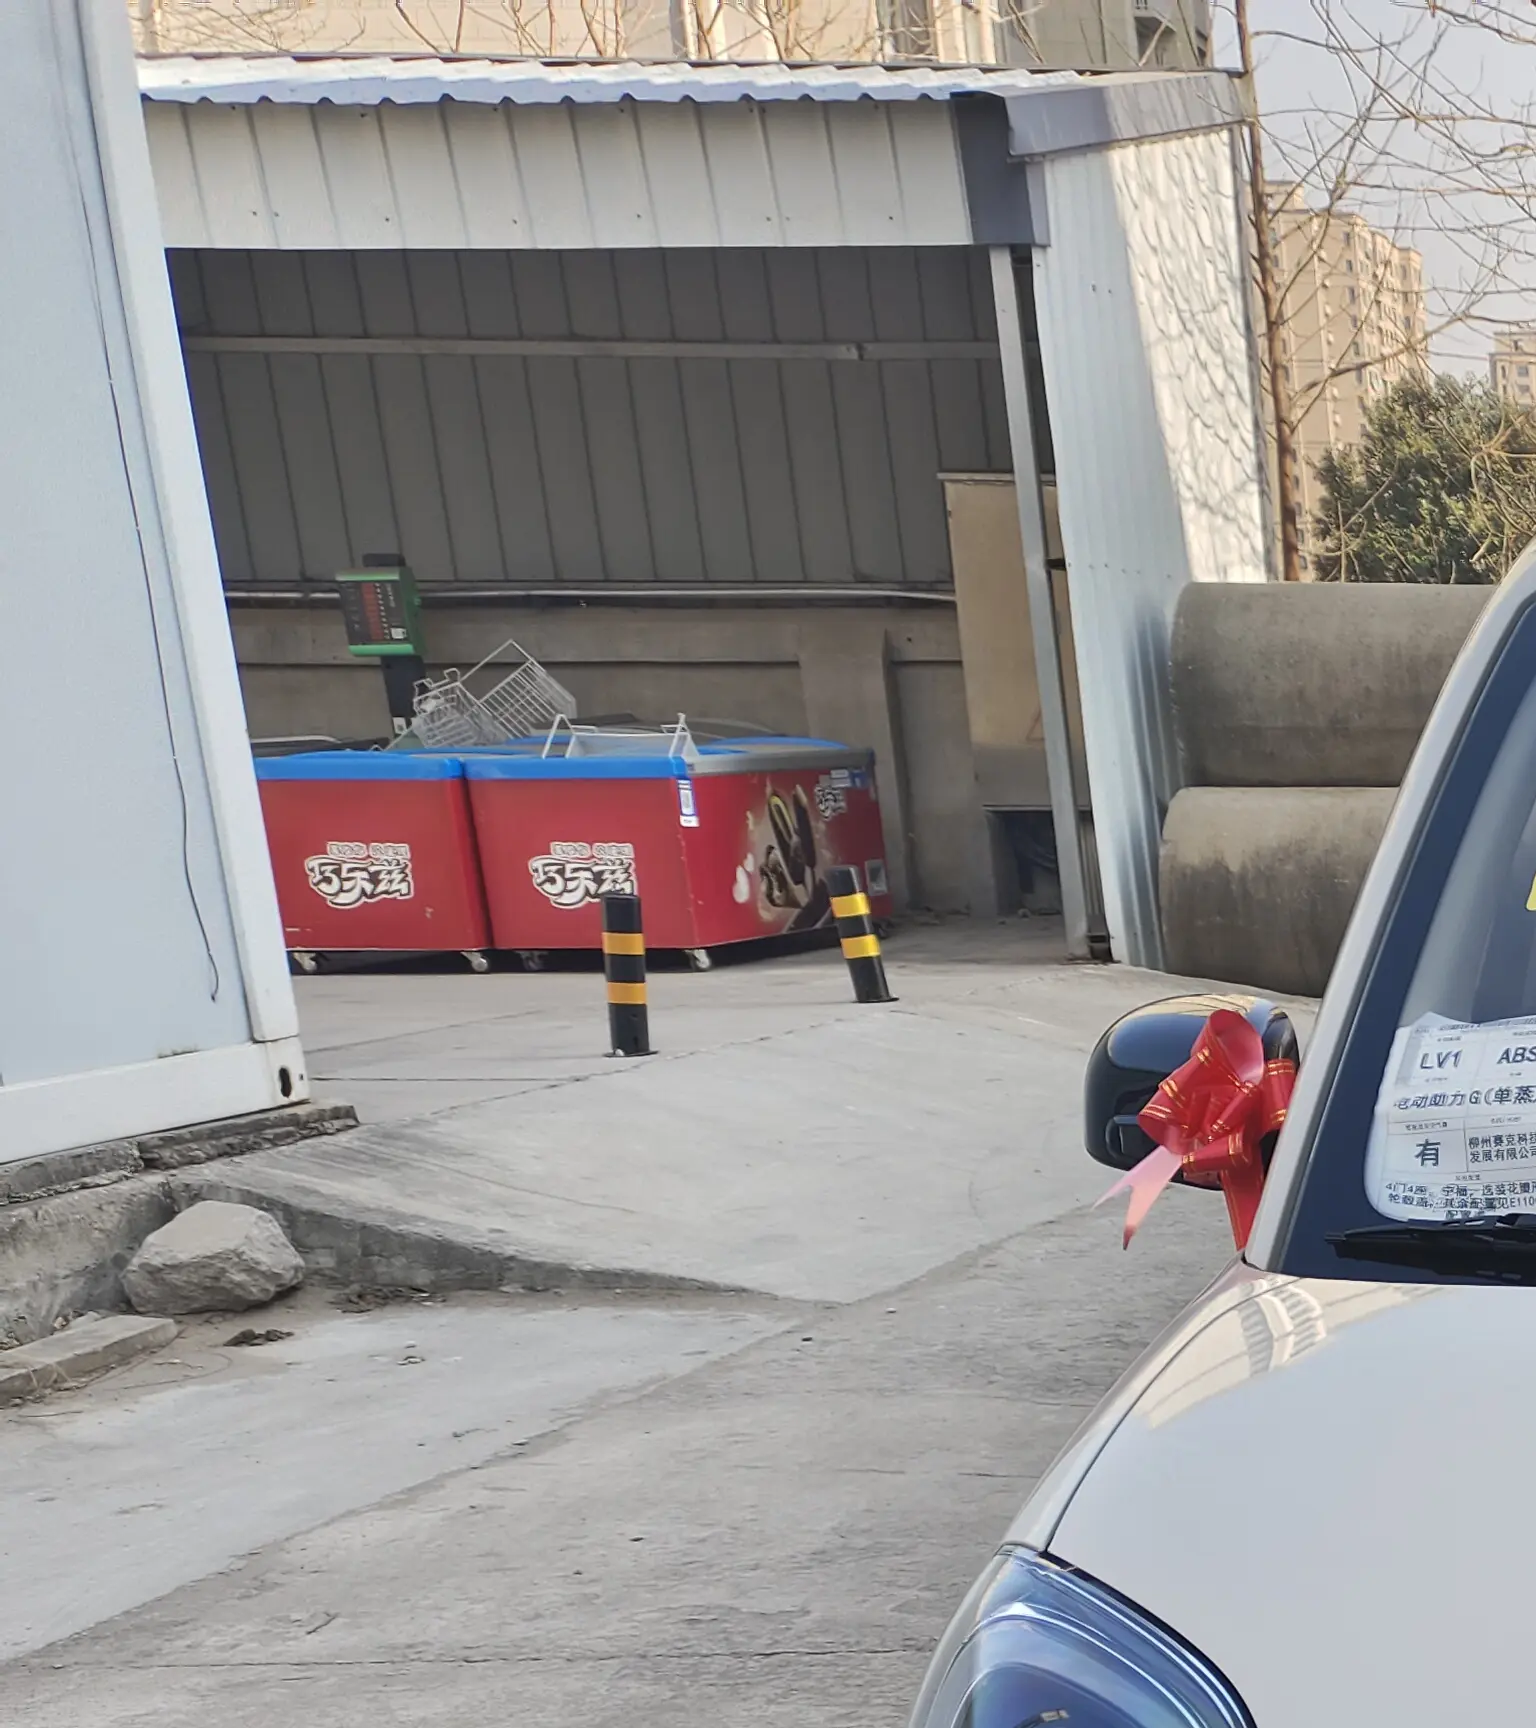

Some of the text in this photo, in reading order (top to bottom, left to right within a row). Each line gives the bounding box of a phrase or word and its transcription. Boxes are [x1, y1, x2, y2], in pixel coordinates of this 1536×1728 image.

[305, 855, 413, 908] 巧乐兹
[529, 855, 637, 908] 巧乐兹
[1420, 1049, 1463, 1070] LV1
[1414, 1138, 1441, 1167] 有
